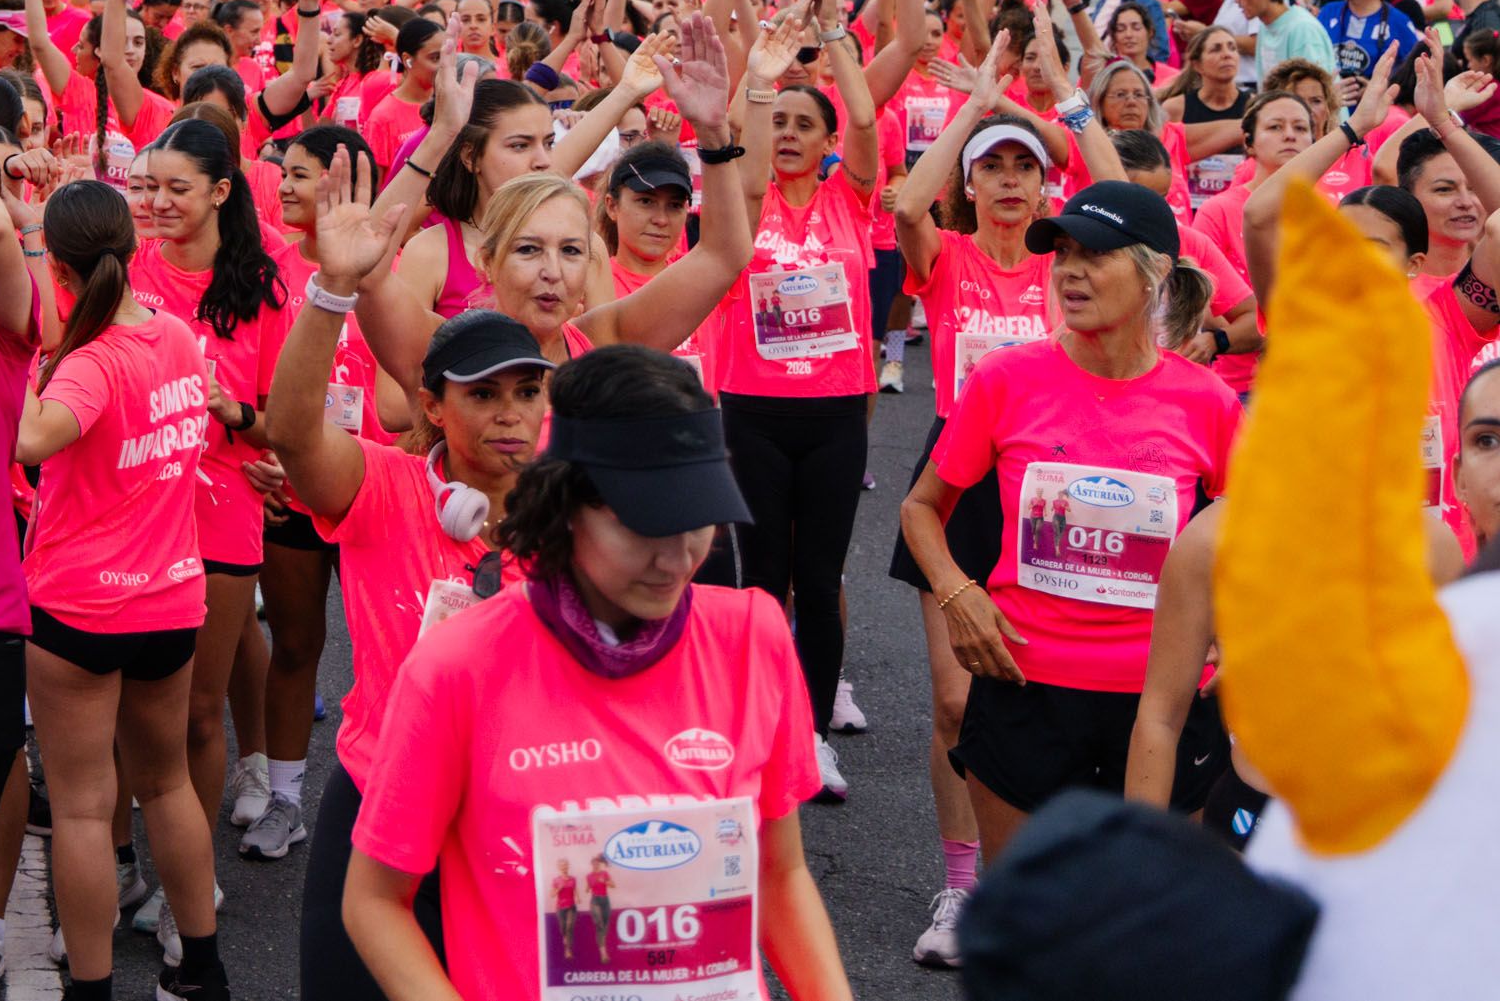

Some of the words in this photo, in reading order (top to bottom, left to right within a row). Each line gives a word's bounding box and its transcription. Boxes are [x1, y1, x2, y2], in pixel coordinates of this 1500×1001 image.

[1089, 205, 1125, 225] Columbia
[131, 288, 165, 307] YSHO
[784, 308, 821, 325] 016
[786, 362, 812, 375] 2026
[1036, 473, 1065, 484] SUMA
[1072, 484, 1130, 503] ASTURIANA
[1068, 526, 1125, 553] 016
[1081, 553, 1108, 565] 1129
[100, 570, 149, 586] OYSHO
[1031, 557, 1064, 570] CARRERA
[1065, 562, 1075, 572] DE
[1076, 564, 1087, 574] LA
[1087, 566, 1112, 577] MUJER
[1123, 570, 1153, 582] CORUÑA
[1034, 572, 1079, 590] OYSHO
[1107, 586, 1149, 599] Santander
[509, 738, 602, 771] OYSHO
[553, 832, 597, 847] SUMA
[613, 839, 695, 860] ASTURIANA
[616, 904, 699, 943] 016
[564, 971, 615, 984] CARRERA
[617, 971, 634, 983] DE
[635, 970, 650, 982] LA
[653, 967, 689, 981] MUJER
[696, 966, 705, 977] A
[706, 958, 739, 976] CORUÑA
